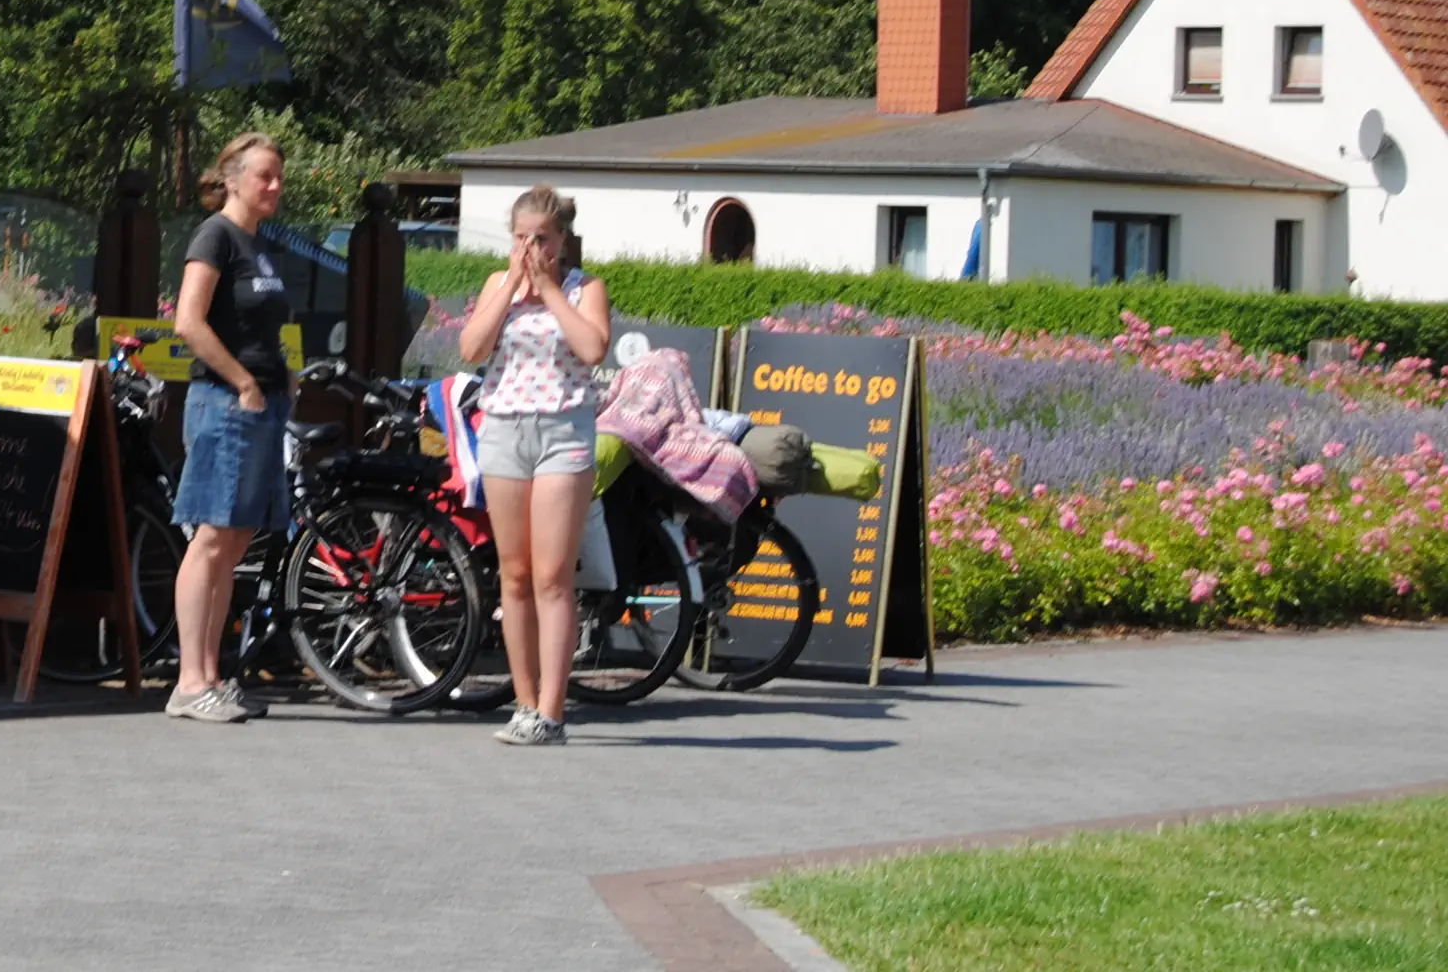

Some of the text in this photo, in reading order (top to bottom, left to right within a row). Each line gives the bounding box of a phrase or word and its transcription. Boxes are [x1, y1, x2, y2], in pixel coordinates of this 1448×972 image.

[753, 363, 898, 405] Coffee to go
